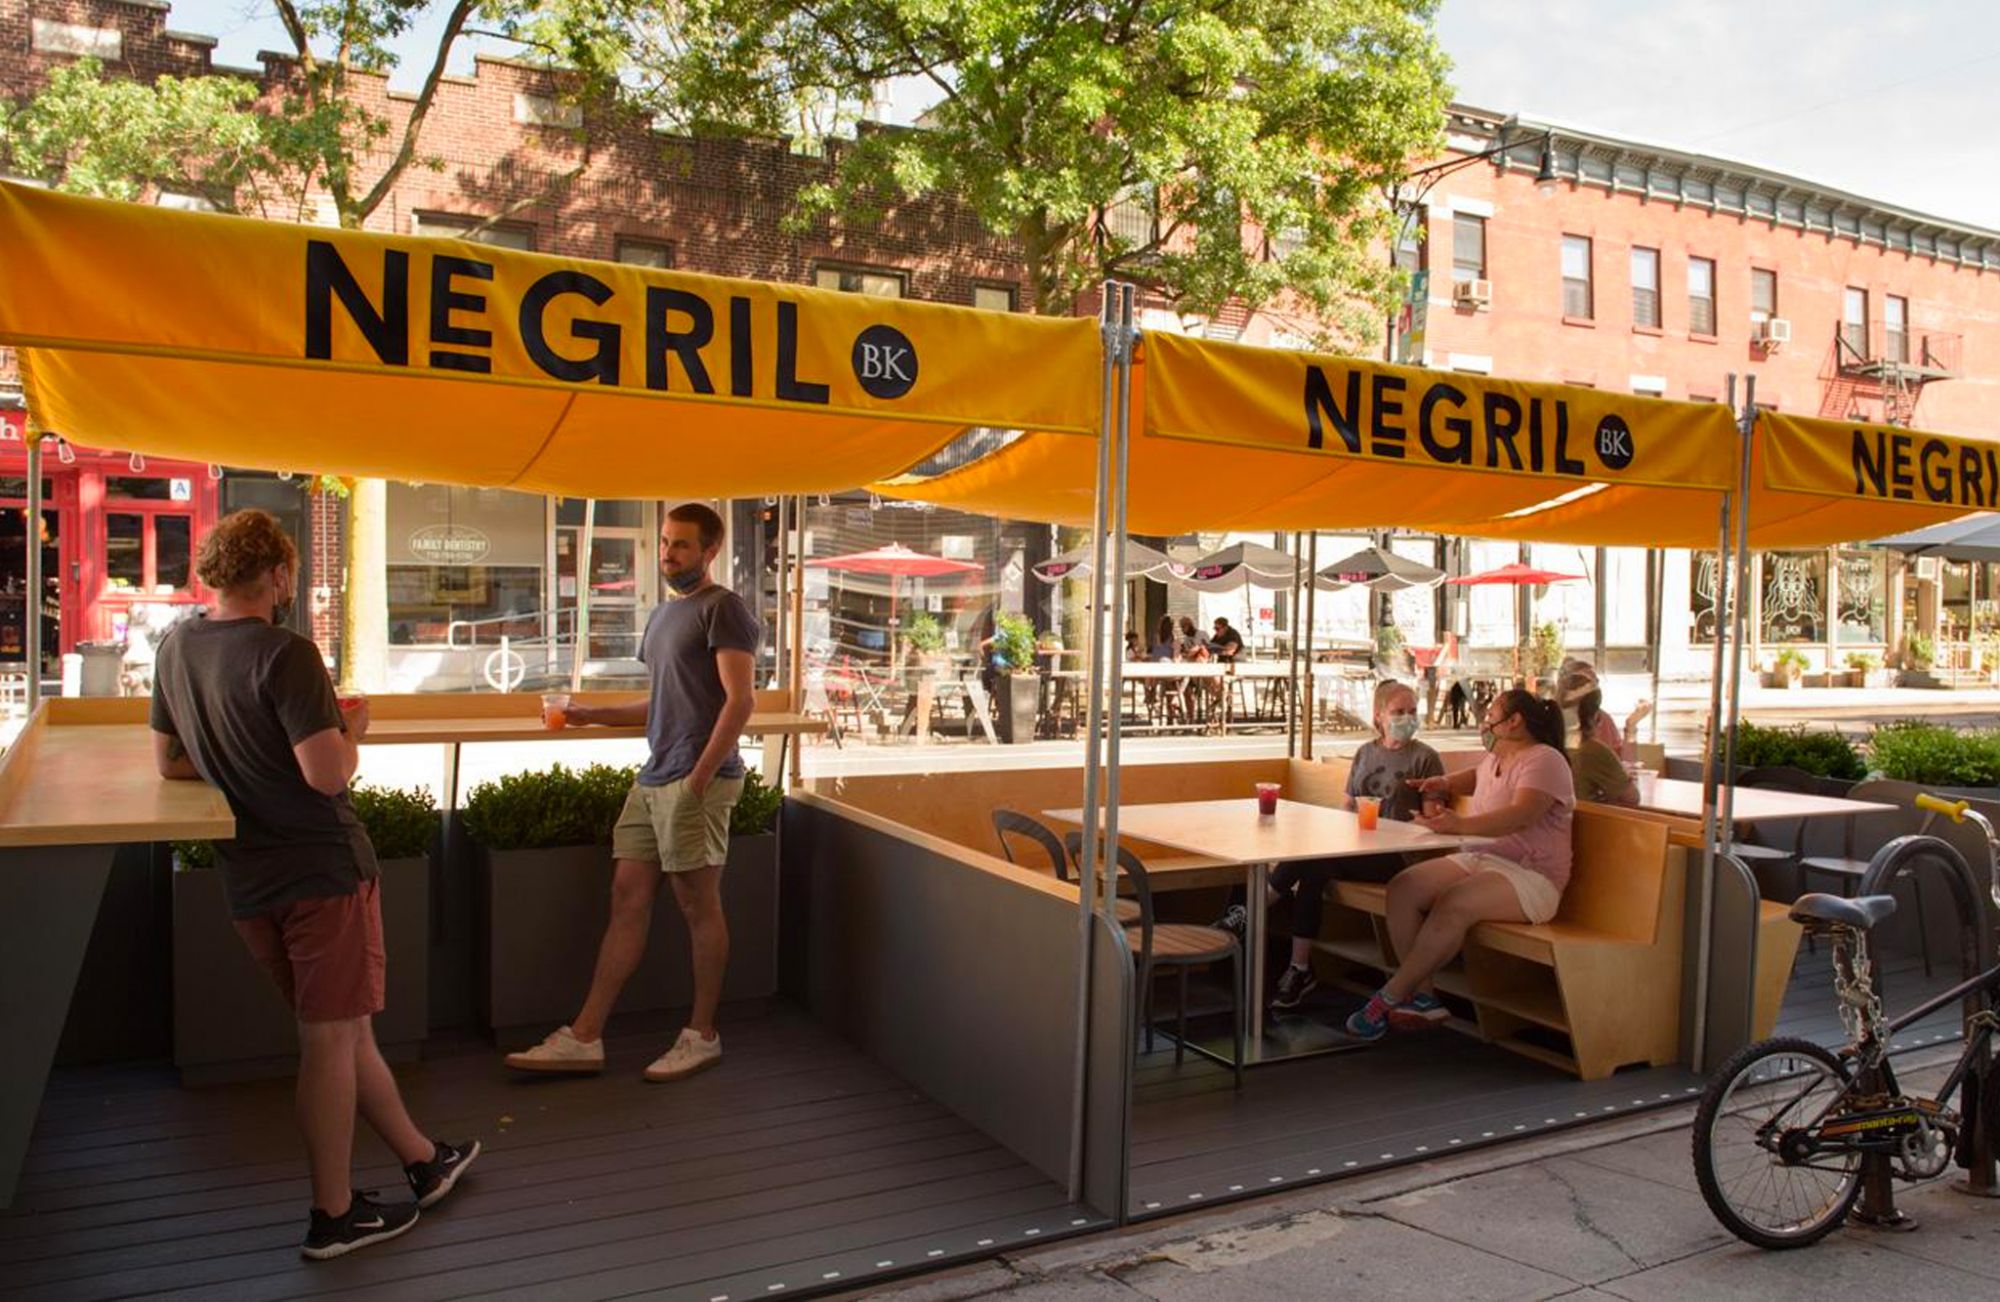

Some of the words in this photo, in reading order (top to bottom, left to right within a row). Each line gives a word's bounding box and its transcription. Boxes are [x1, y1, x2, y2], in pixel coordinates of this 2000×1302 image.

[305, 239, 830, 405] NEGRIL
[861, 343, 911, 382] BK
[1304, 365, 1586, 476] NEGRIL
[1600, 428, 1630, 457] BK
[412, 538, 442, 550] FAMILY
